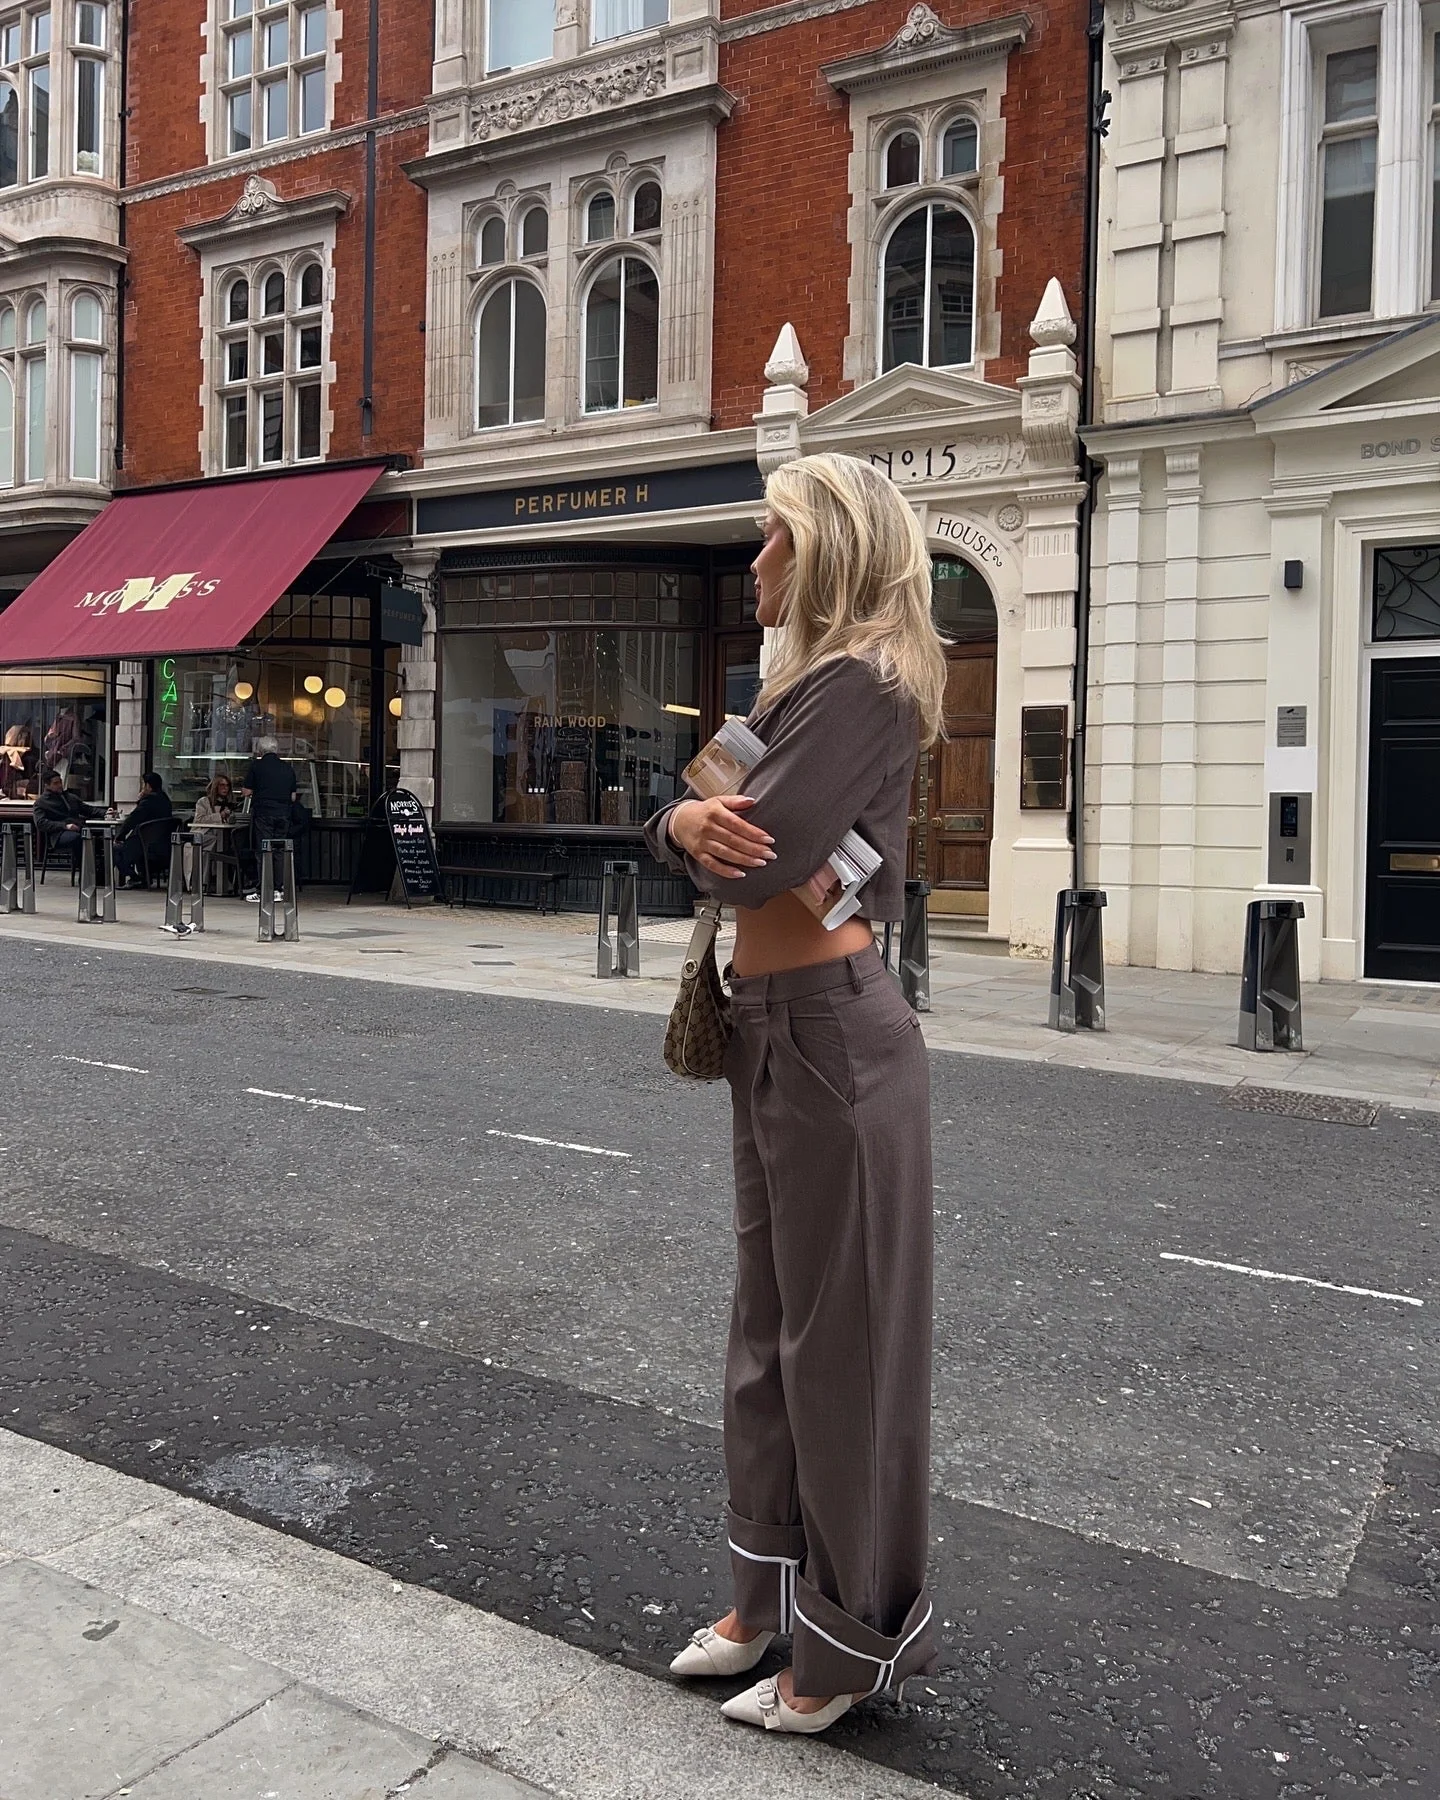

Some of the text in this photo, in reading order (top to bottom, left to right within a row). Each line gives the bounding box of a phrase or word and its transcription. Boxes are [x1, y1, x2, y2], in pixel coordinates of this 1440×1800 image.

[1360, 438, 1421, 459] BOND
[515, 484, 648, 515] PERFUMER H
[935, 517, 998, 562] HOUSE
[161, 658, 178, 748] CAFE
[534, 714, 606, 728] RAIN WOOD
